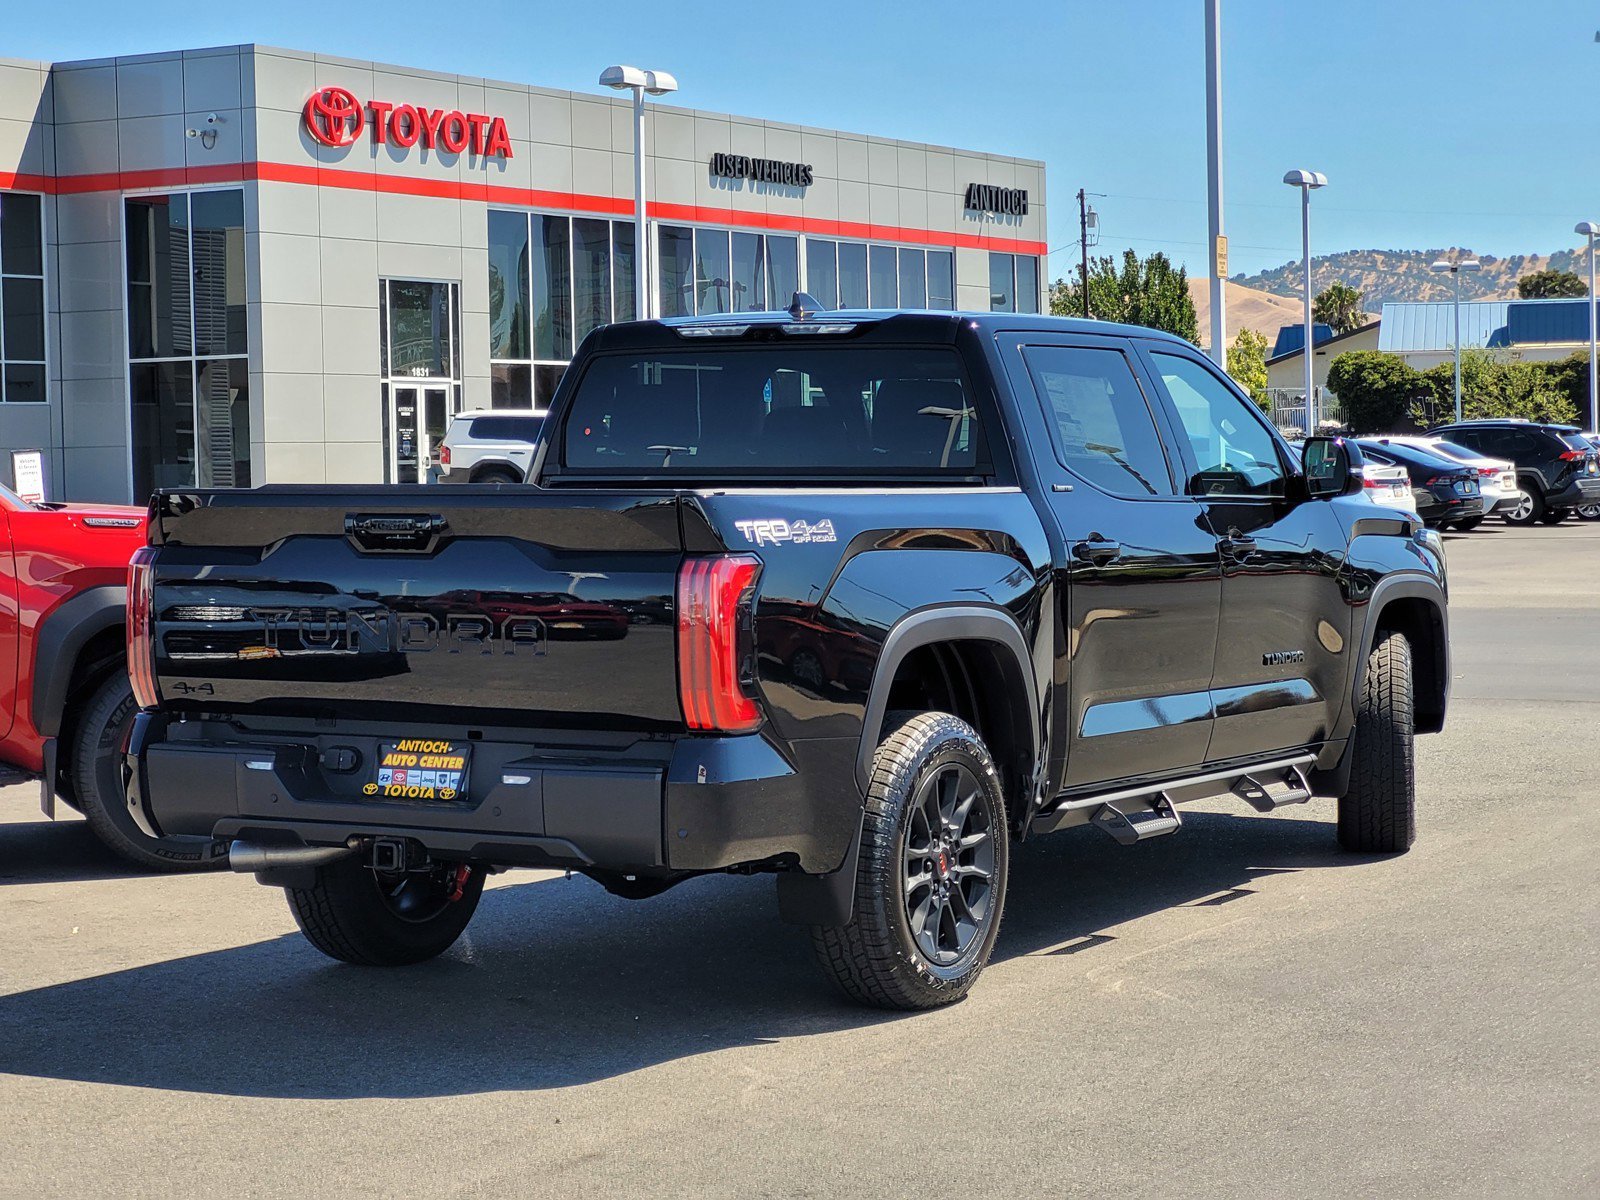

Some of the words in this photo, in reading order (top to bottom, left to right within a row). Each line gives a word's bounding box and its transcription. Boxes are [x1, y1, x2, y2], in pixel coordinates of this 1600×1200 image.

[367, 100, 513, 158] TOYOTA
[713, 152, 752, 179] USED
[751, 158, 813, 187] VEHICLES
[966, 183, 1028, 215] ANTIOCH
[411, 367, 429, 377] 1831
[734, 519, 793, 547] TRD
[247, 606, 549, 657] TUNDRA
[397, 740, 449, 753] ANTIOCH
[383, 754, 417, 767] AUTO
[420, 755, 464, 769] CENTER
[384, 784, 435, 798] TOYOTA
